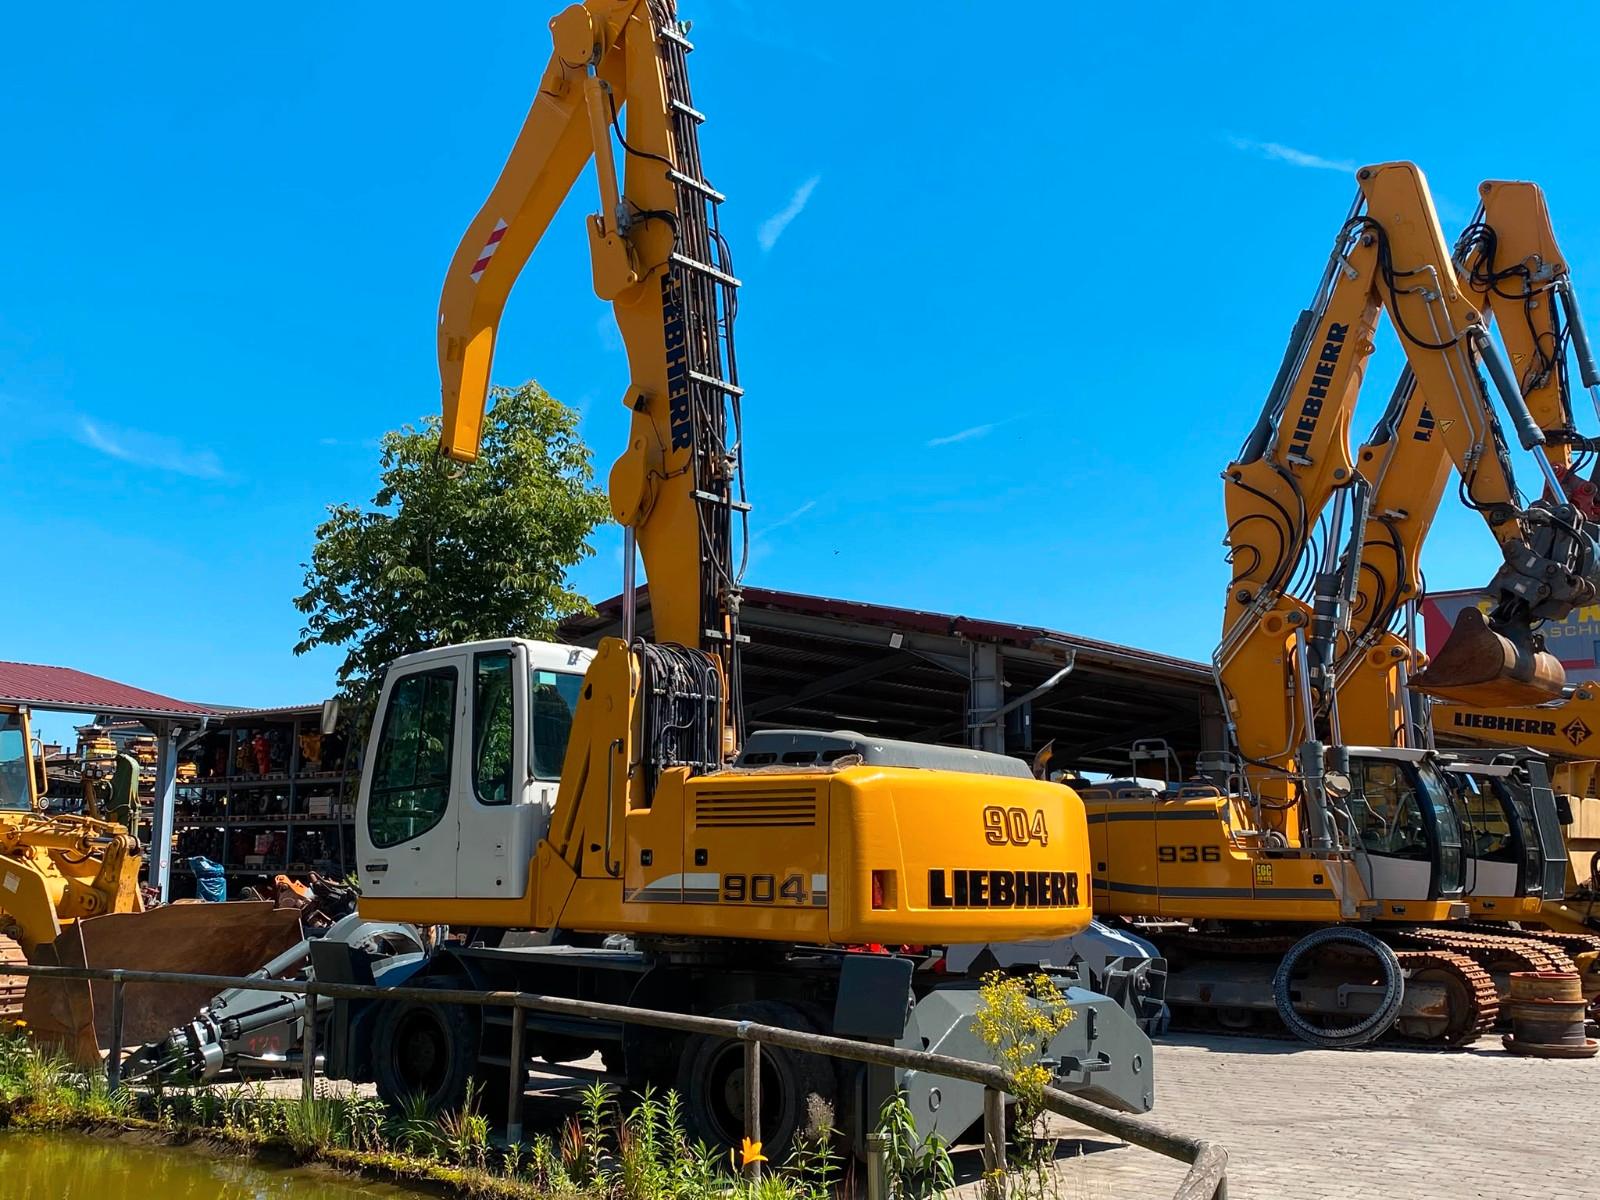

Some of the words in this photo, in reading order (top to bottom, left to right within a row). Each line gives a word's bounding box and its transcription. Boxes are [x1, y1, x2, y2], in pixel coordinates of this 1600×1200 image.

[1288, 322, 1349, 456] LIEBHERR
[1454, 712, 1556, 735] LIEBHERR
[983, 806, 1049, 847] 904
[1158, 846, 1221, 862] 936
[723, 874, 809, 904] 904
[928, 869, 1080, 909] LIEBHERR
